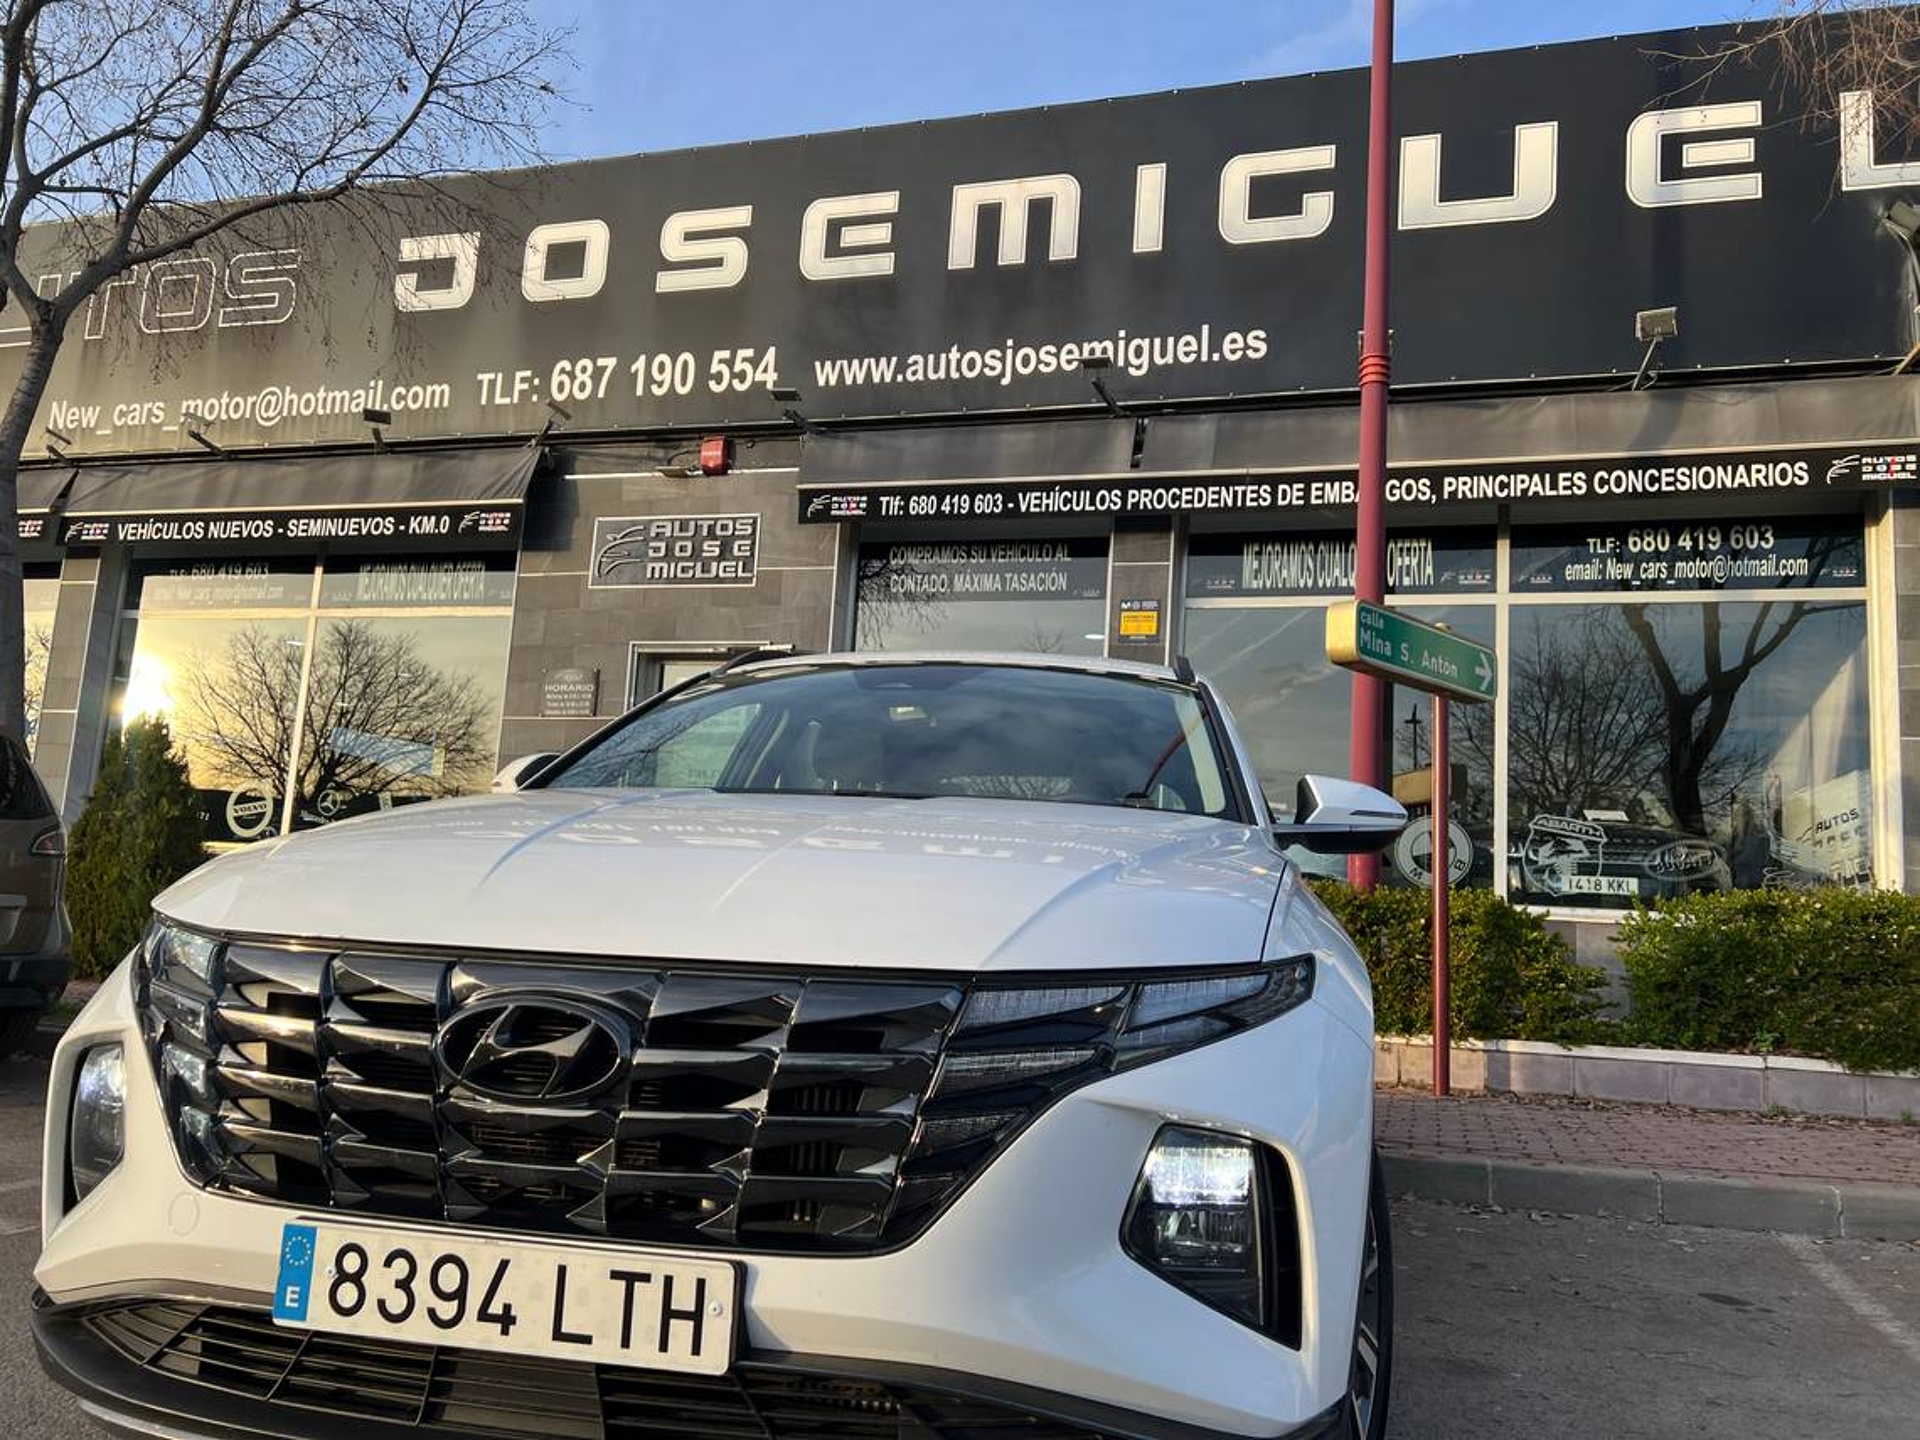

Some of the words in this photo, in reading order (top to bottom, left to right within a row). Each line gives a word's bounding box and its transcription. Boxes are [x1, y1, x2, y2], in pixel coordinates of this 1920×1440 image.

[814, 324, 1268, 386] www.autosjosemiguel.es
[477, 372, 540, 407] TLF:
[550, 357, 616, 401] 687
[630, 352, 695, 396] 190
[708, 347, 778, 391] 554
[908, 496, 938, 514] 680
[940, 494, 970, 513] 419
[974, 493, 1003, 513] 603
[1018, 485, 1121, 512] VEHÍCULOS
[1126, 484, 1271, 510] PROCEDENTES
[1277, 482, 1304, 506] DE
[1310, 477, 1436, 505] EMBGOS,
[1443, 471, 1587, 500] PRINCIPALES
[1593, 461, 1810, 495] CONCESIONARIOS
[117, 519, 204, 540] VEHÍCULOS
[208, 519, 274, 539] NUEVOS
[287, 516, 395, 537] SEMINUEVOS
[409, 515, 449, 535] KM.0
[650, 519, 753, 537] AUTOS
[1586, 537, 1620, 554] TLF:
[1627, 528, 1670, 553] 680
[1677, 526, 1722, 551] 419
[1730, 525, 1774, 551] 603
[648, 540, 751, 557] JOSE
[889, 545, 966, 565] COMPRAMOS
[970, 545, 987, 562] SU
[990, 541, 1051, 563] VEHÍCULO
[1055, 545, 1071, 562] AL
[646, 561, 754, 578] MIGUEL
[1241, 541, 1313, 590] MEJORAMOS
[1386, 537, 1434, 586] OFERTA
[1565, 559, 1602, 581] email:
[1606, 554, 1809, 585] New_cars_motor@hotmail.com
[953, 568, 1000, 593] MÁXIMA
[1005, 567, 1067, 592] TASACIÓN
[1360, 628, 1392, 657] Mina
[1400, 643, 1414, 664] S.
[545, 683, 594, 692] HORARIO
[1537, 818, 1600, 836] ABARTH
[1815, 808, 1859, 834] AUTOS
[285, 1285, 300, 1308] E
[327, 1242, 518, 1336] 8394
[551, 1263, 707, 1357] LTH
